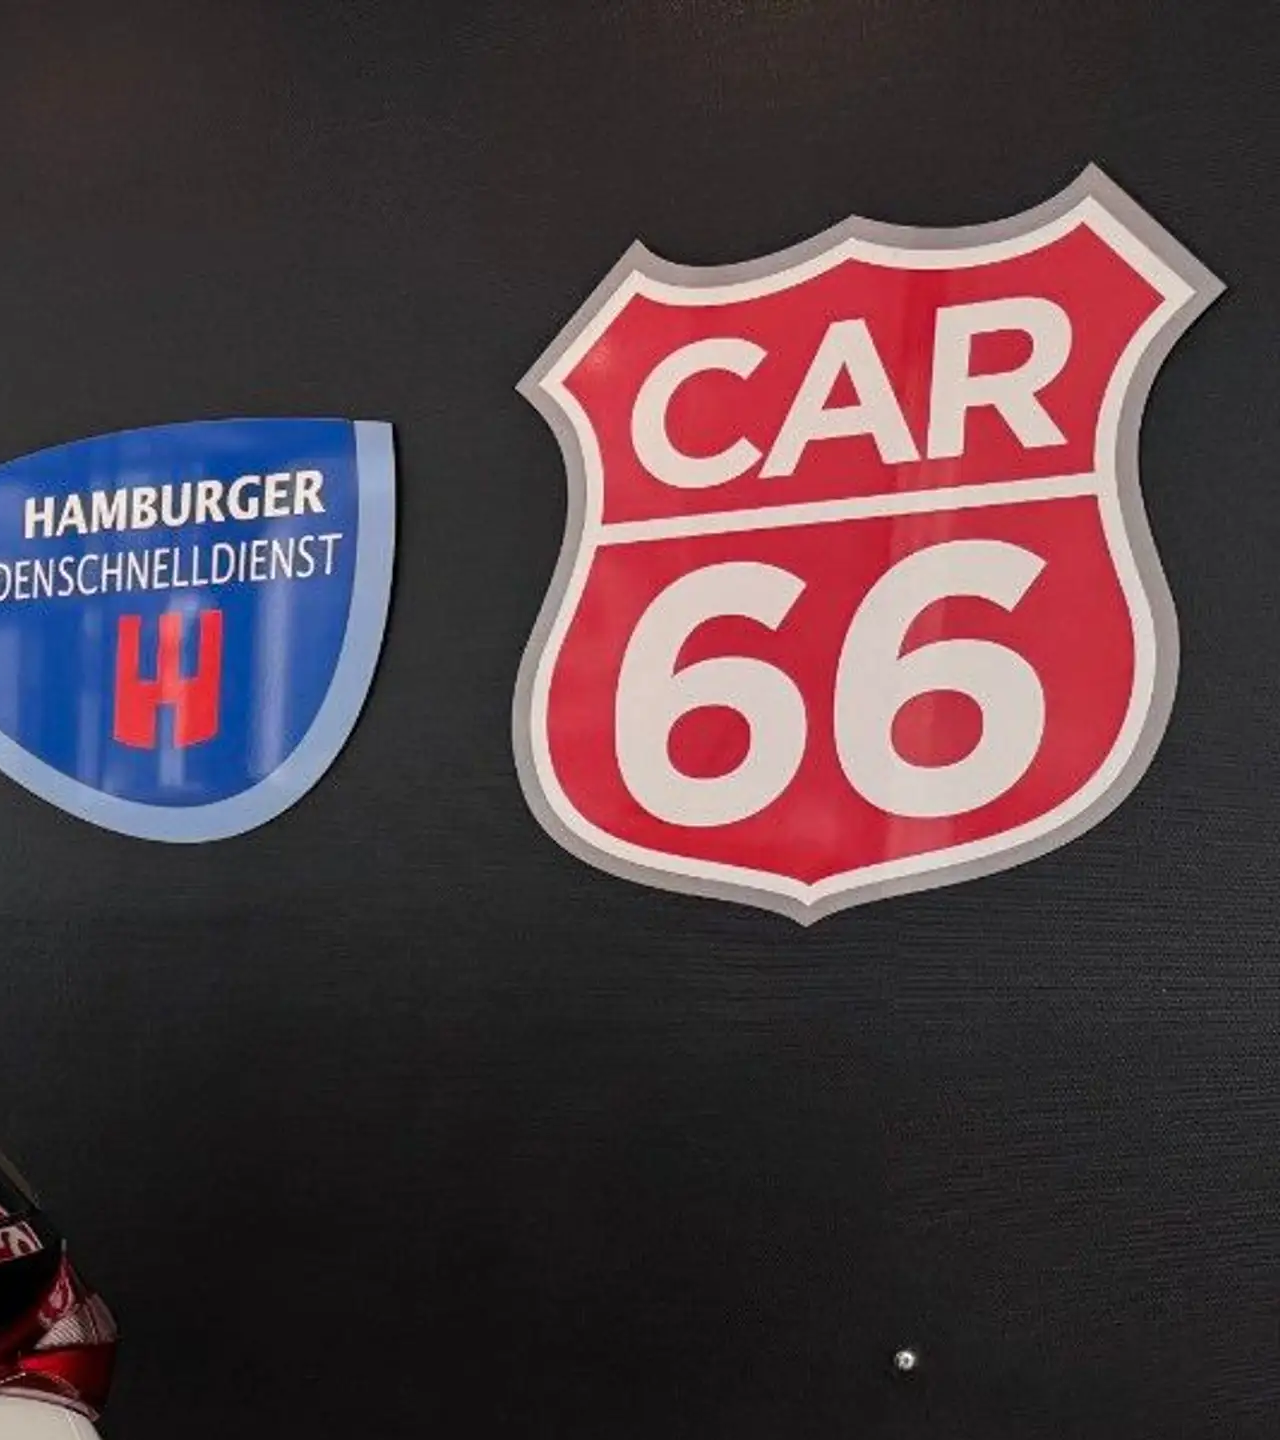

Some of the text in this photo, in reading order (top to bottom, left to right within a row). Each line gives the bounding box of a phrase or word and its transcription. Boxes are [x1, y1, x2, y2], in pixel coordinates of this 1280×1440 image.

[631, 295, 1072, 489] CAR
[24, 469, 326, 539] HAMBURGER
[615, 538, 1047, 828] 66
